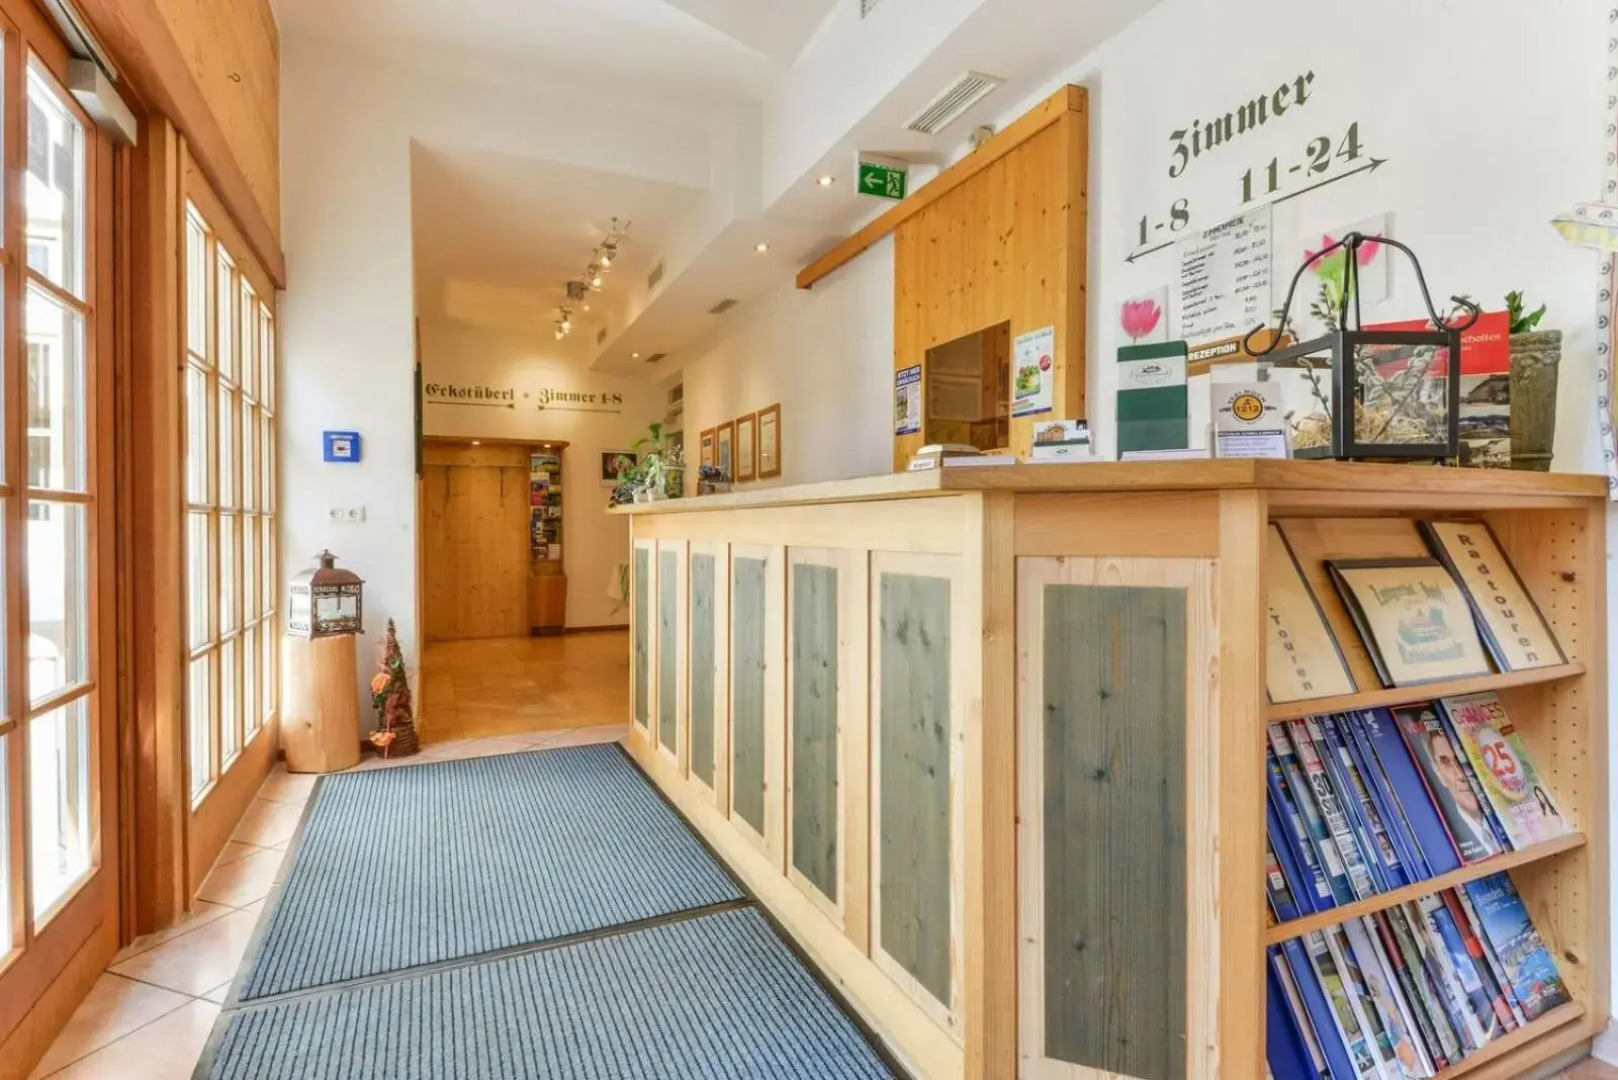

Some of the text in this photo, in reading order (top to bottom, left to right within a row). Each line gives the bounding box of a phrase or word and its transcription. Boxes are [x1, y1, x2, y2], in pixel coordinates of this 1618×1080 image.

[1168, 69, 1315, 178] Zimmer
[1238, 121, 1364, 205] 11-24
[1137, 198, 1190, 247] 1-8
[1188, 342, 1237, 361] REZEPTION
[425, 382, 515, 401] Eckstüberl
[538, 387, 622, 405] Zimmer 1-8
[1457, 533, 1540, 662] Radtouren
[1482, 741, 1518, 777] 25
